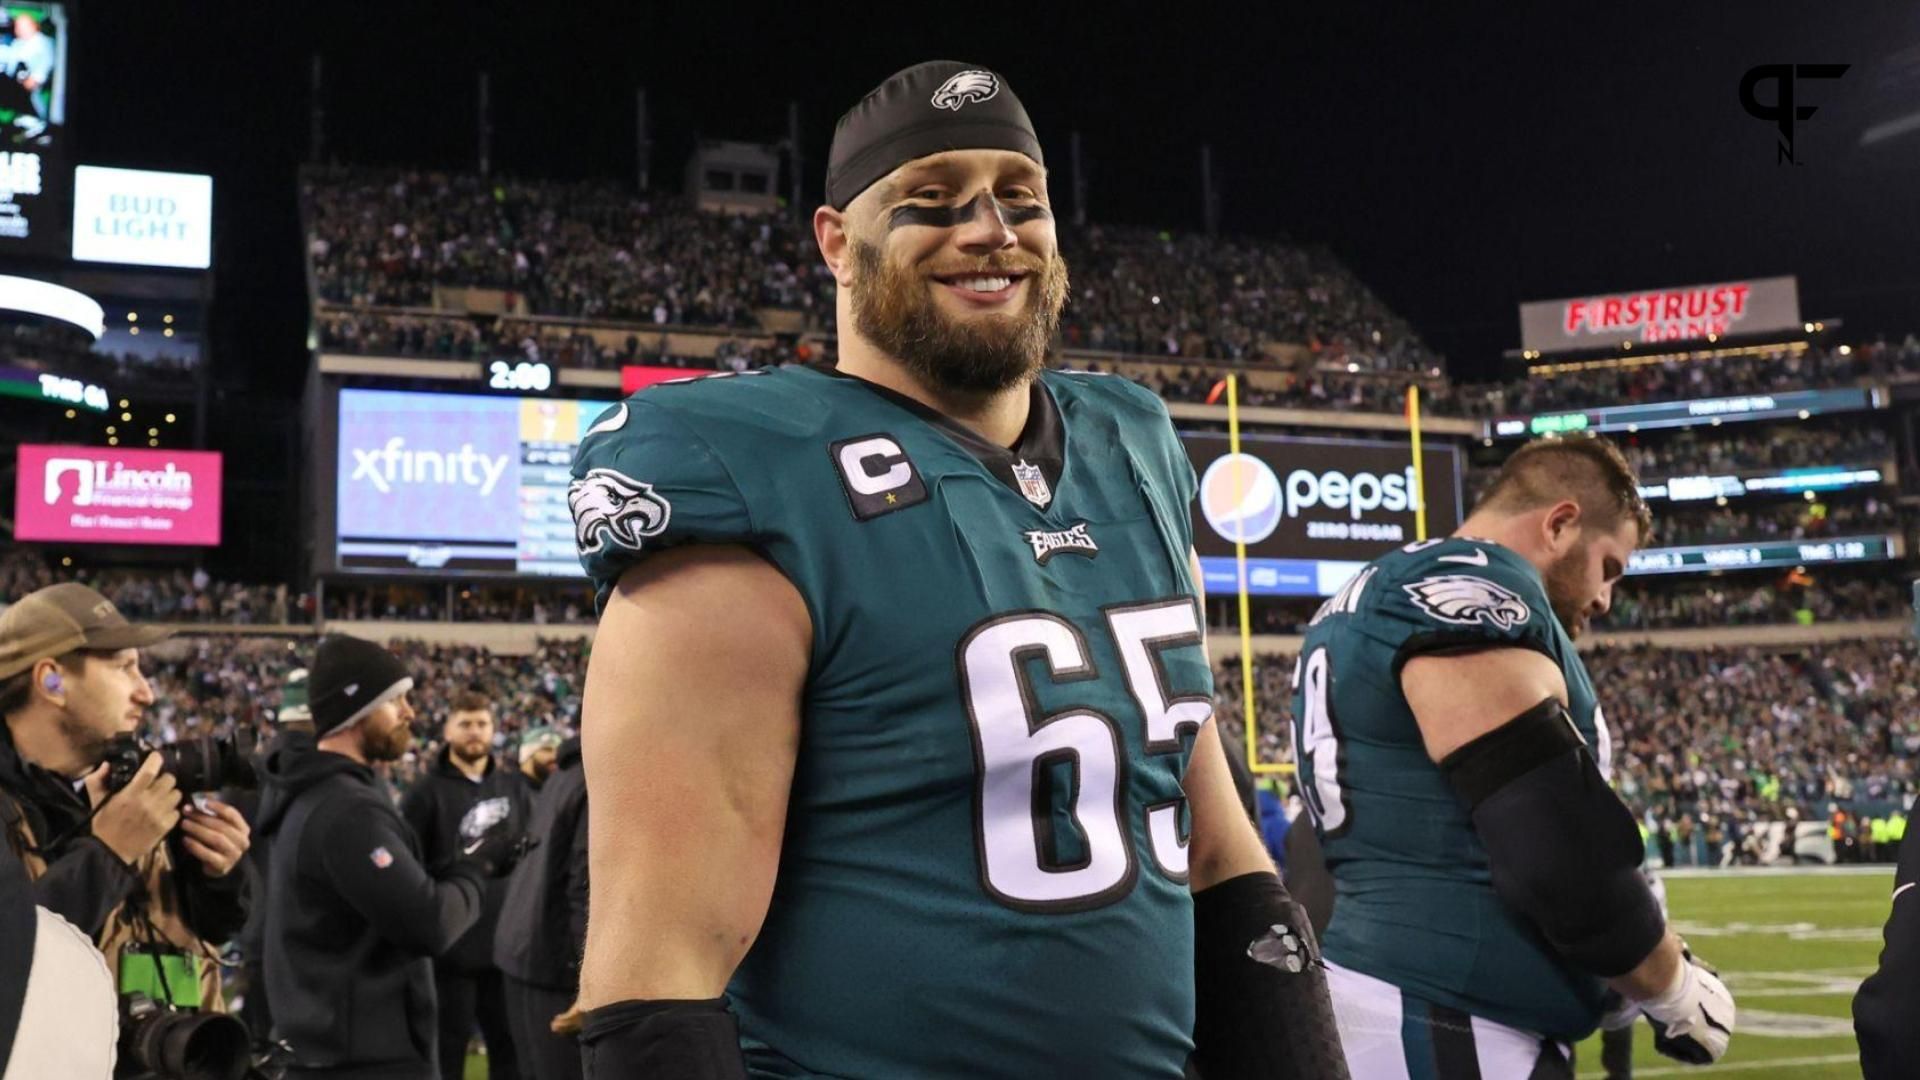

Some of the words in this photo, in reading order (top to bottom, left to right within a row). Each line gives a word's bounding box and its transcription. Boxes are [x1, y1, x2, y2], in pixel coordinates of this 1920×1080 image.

[108, 194, 177, 217] BUD
[93, 216, 190, 241] LIGHT
[1565, 284, 1751, 331] FIRSTRUST
[489, 361, 551, 390] 2:00
[96, 461, 192, 492] Lincoln
[352, 437, 508, 496] xfinity
[839, 437, 912, 495] C
[1286, 465, 1423, 520] pepsi
[1022, 522, 1099, 561] EAGLES
[1307, 521, 1348, 540] ZERO
[1350, 523, 1403, 542] SUGAR
[960, 598, 1213, 910] 65
